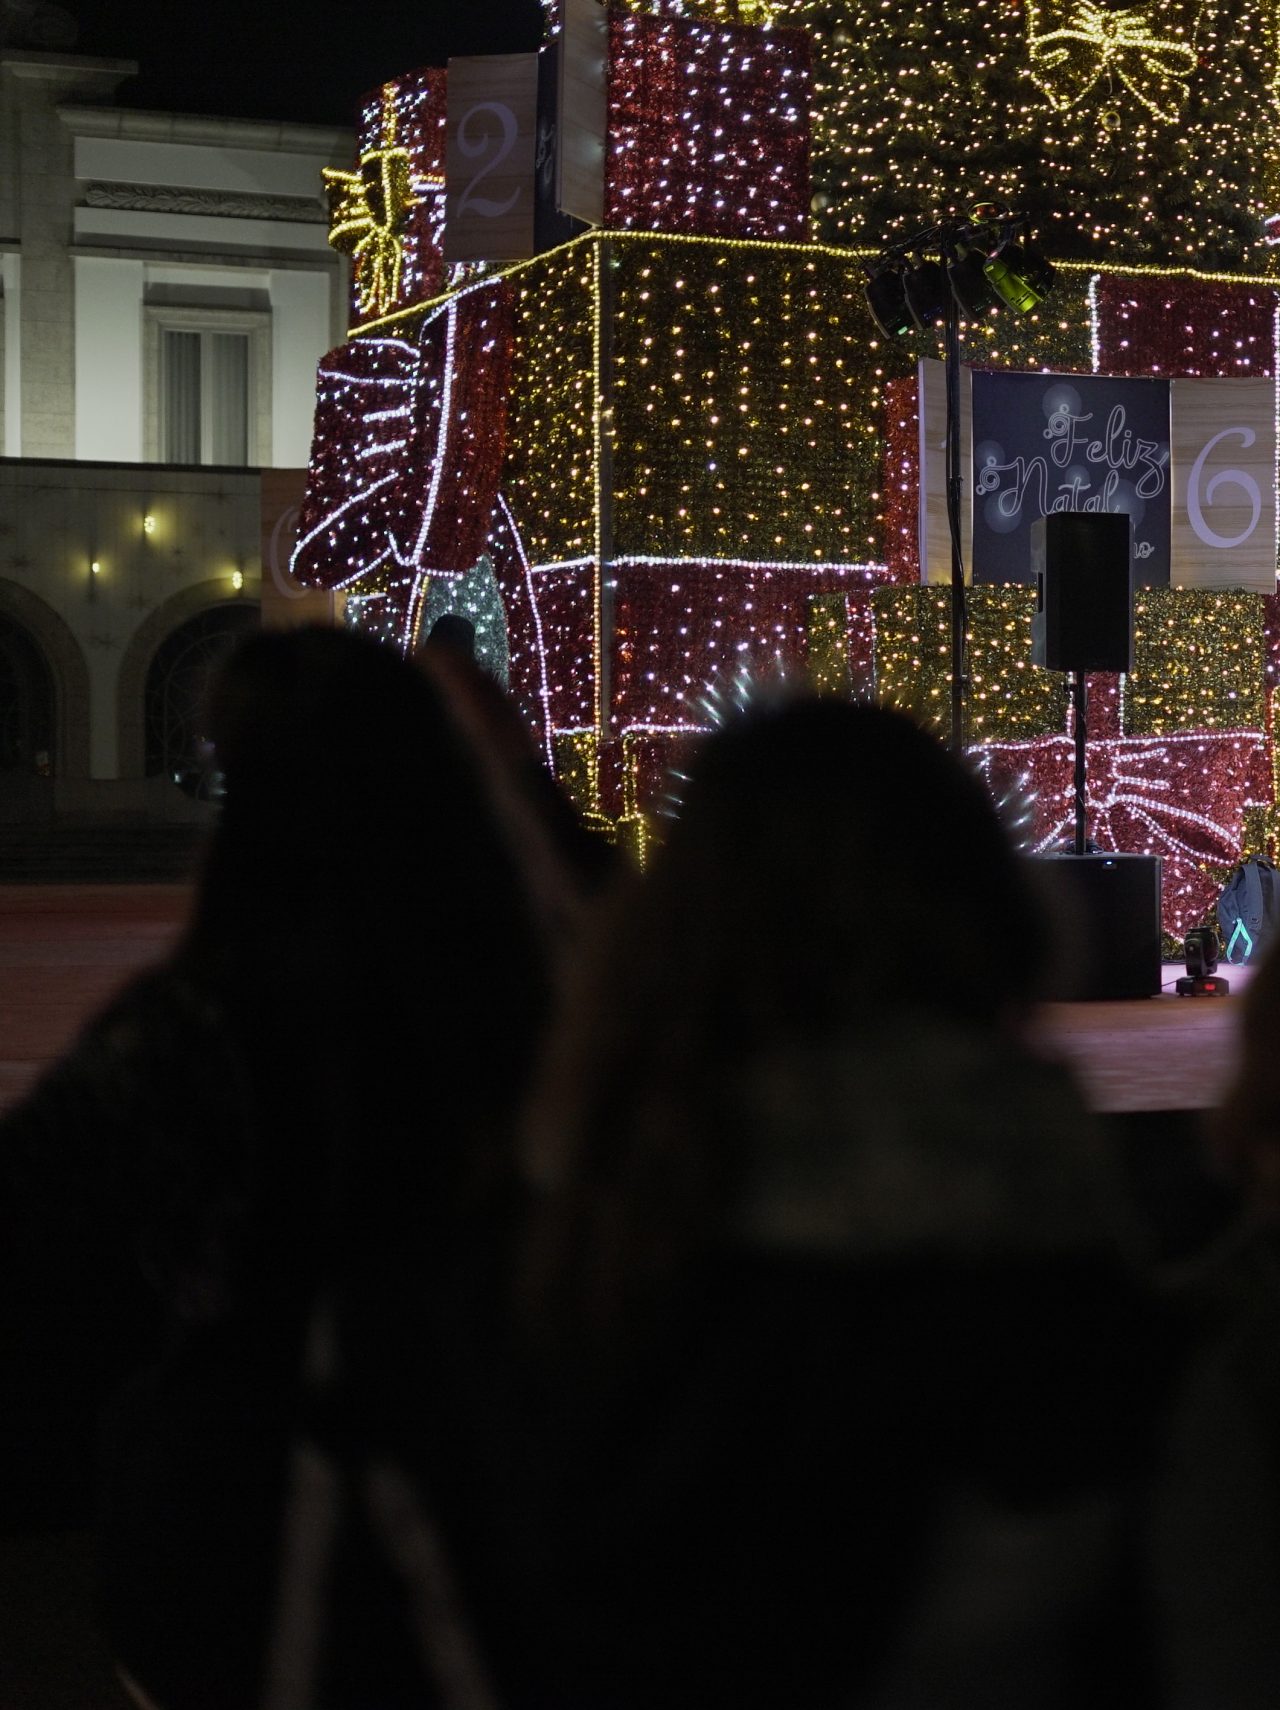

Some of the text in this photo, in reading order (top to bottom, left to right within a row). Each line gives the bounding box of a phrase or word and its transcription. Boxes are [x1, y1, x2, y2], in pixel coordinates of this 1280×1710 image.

[458, 102, 521, 218] 2
[976, 456, 1120, 517] Natal
[1043, 404, 1170, 499] Feliz
[1187, 427, 1262, 548] 6
